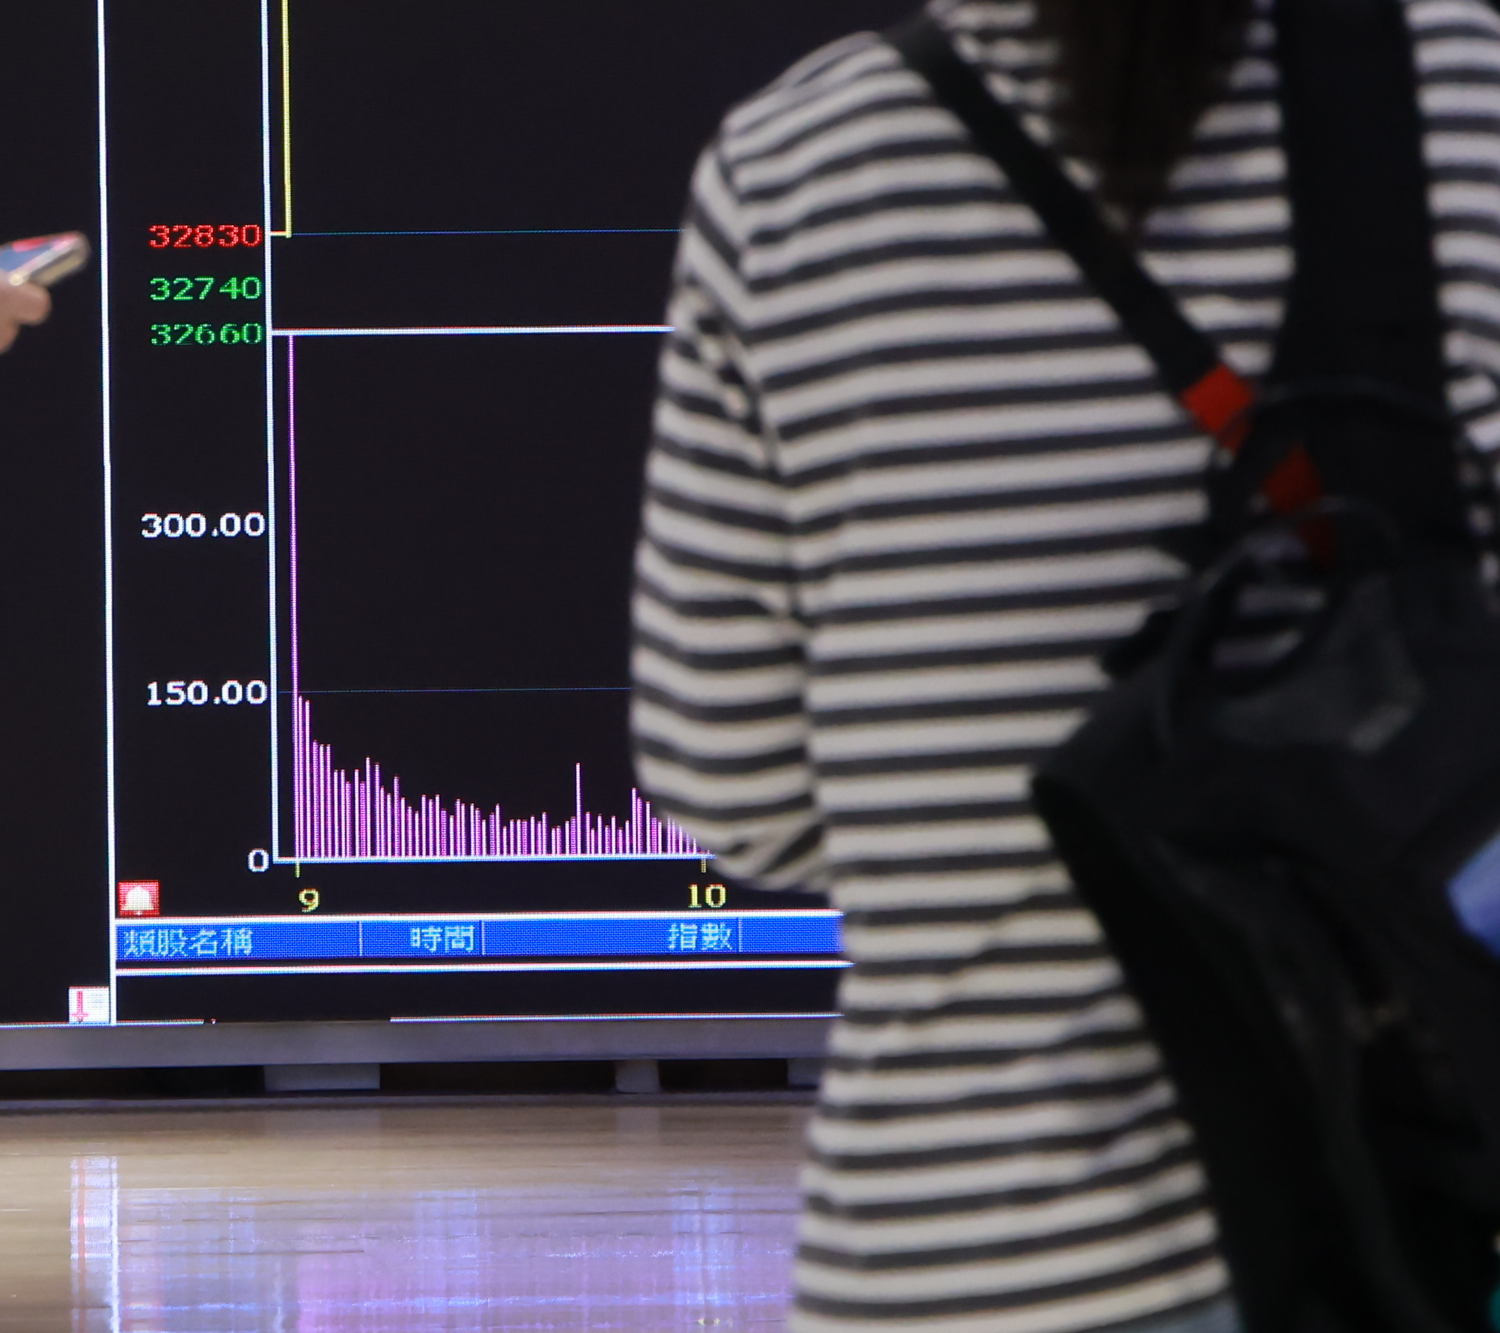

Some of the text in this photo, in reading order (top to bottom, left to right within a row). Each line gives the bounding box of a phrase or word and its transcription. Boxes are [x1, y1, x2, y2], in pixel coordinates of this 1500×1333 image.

[149, 224, 262, 248] 32830
[150, 277, 261, 300] 32740
[142, 513, 265, 537] 300.00
[148, 680, 267, 705] 150.00
[690, 886, 725, 906] 10
[413, 926, 473, 950] 時間
[668, 923, 732, 951] 指數
